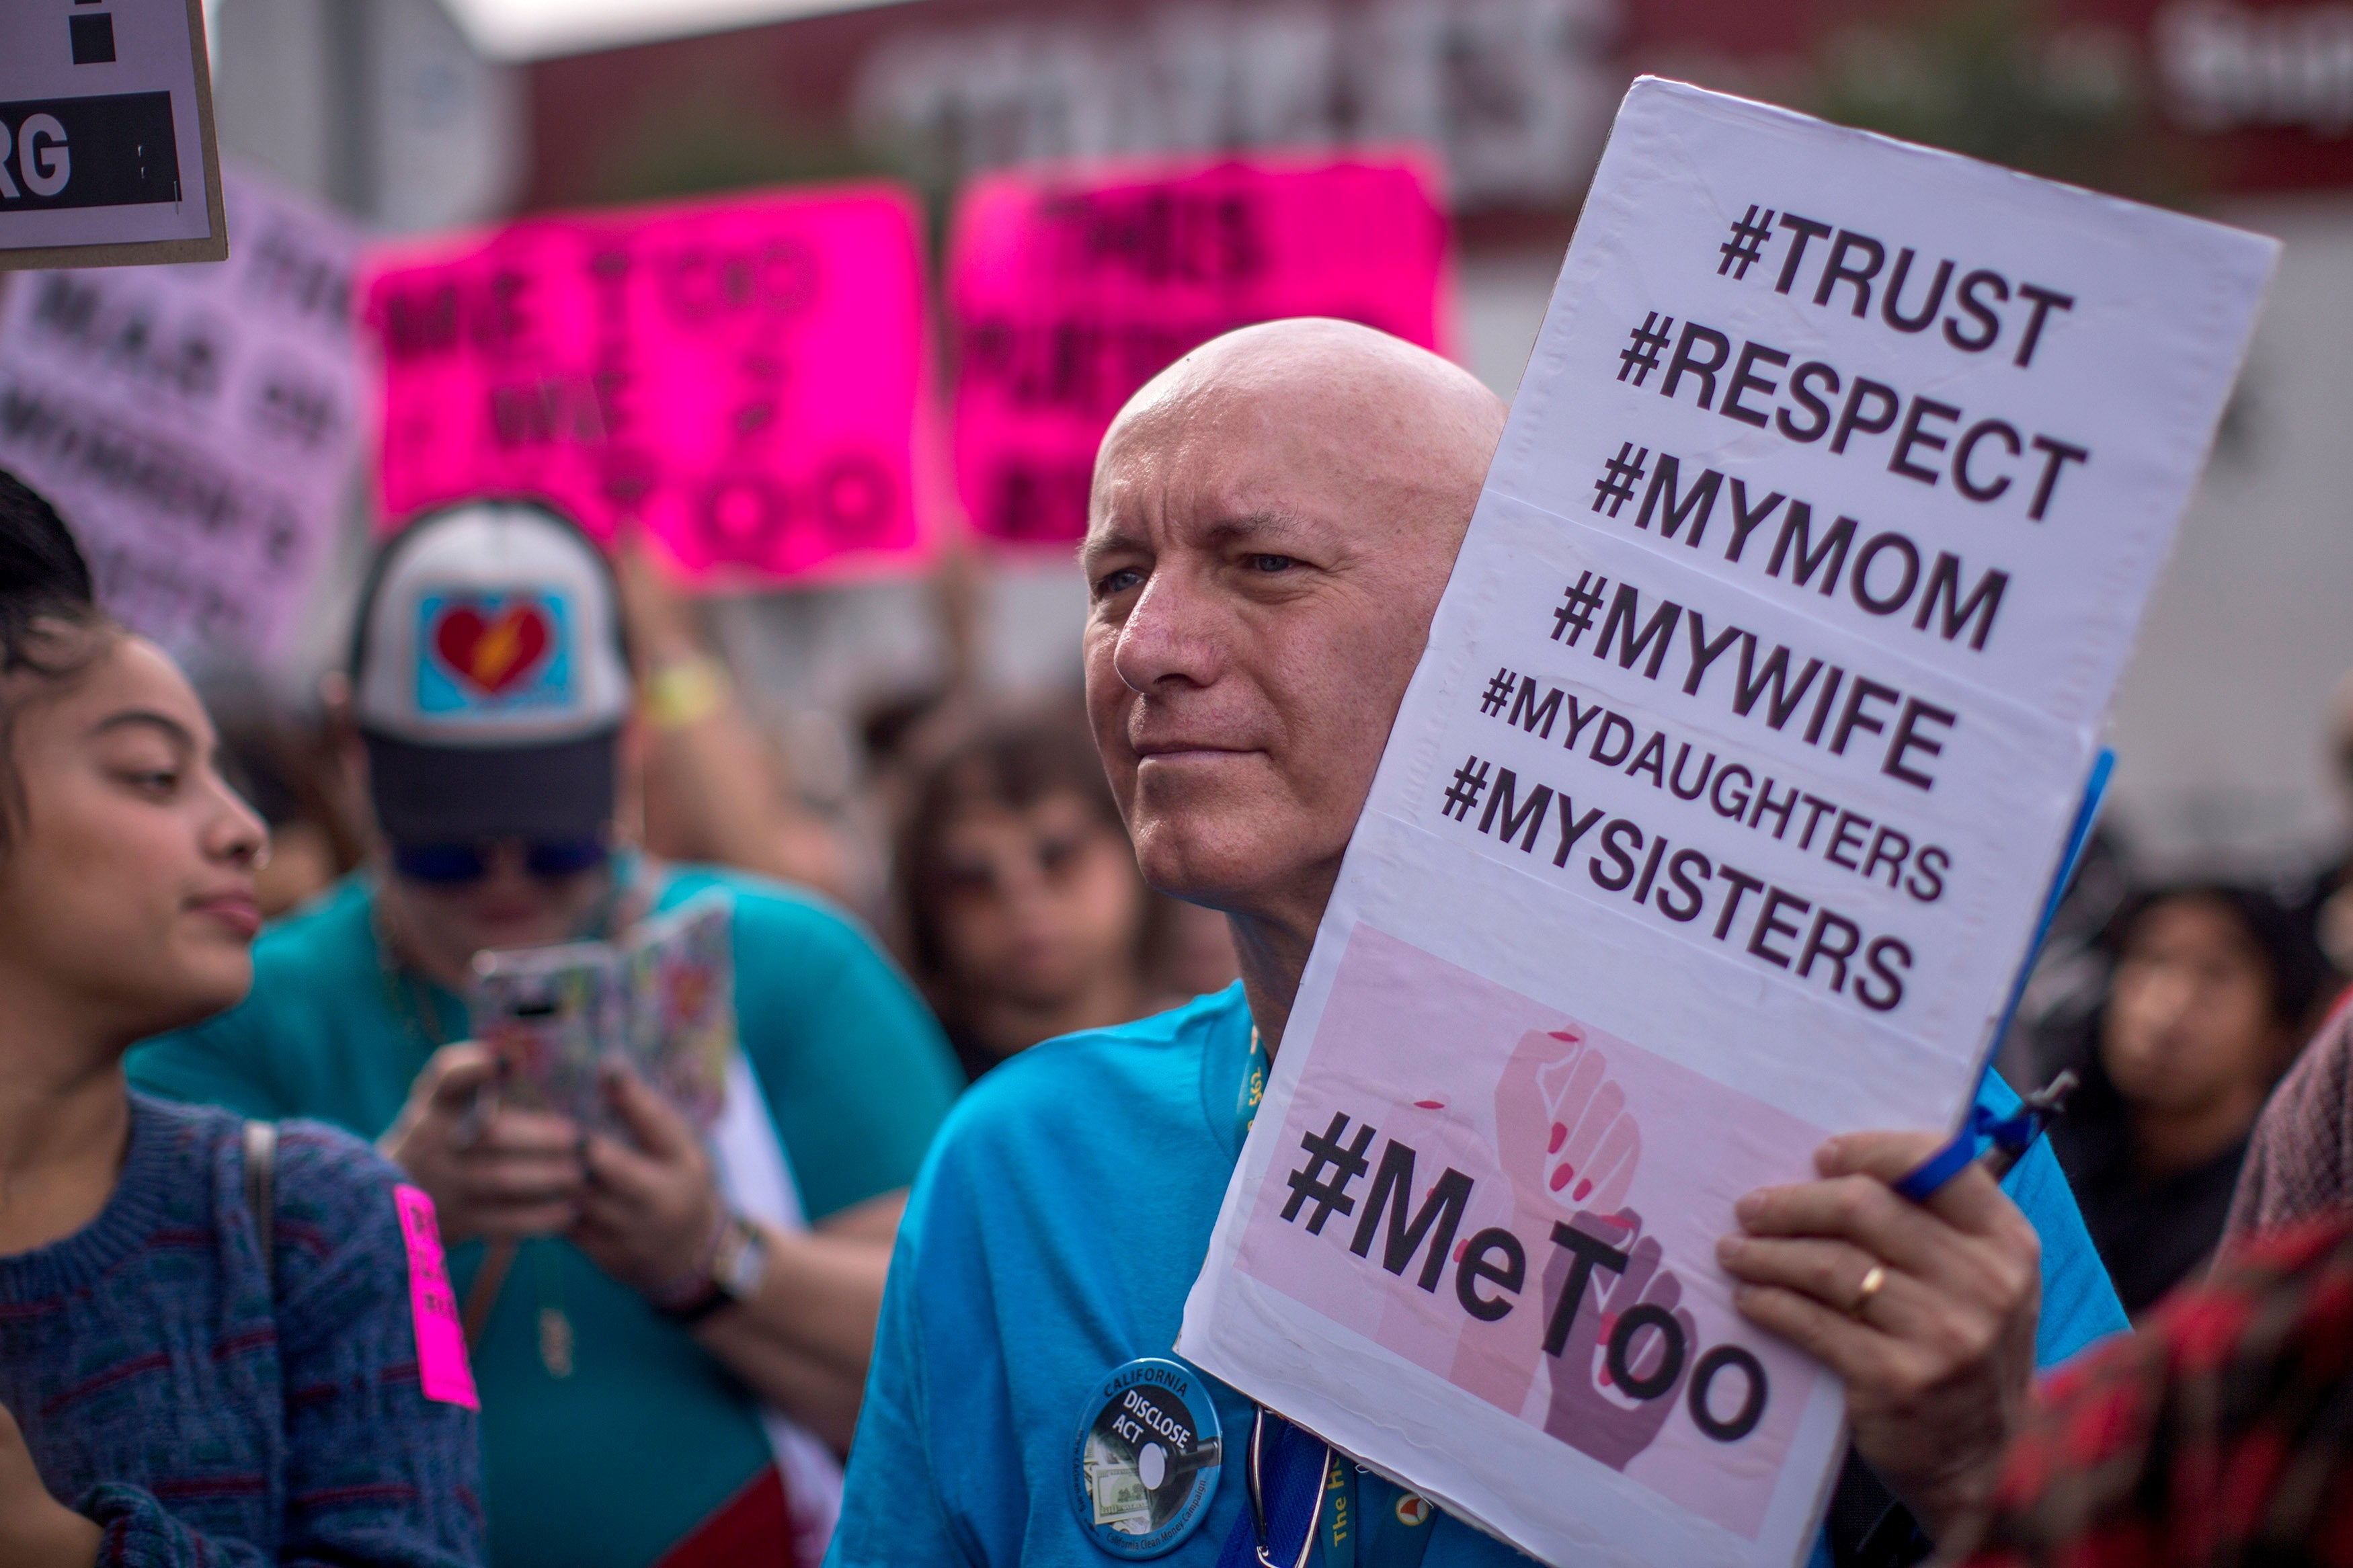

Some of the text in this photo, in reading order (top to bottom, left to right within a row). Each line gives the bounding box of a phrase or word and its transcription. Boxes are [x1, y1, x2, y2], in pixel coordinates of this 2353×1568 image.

[1716, 204, 2075, 369] #TRUST
[1616, 311, 2089, 522] #RESPECT
[1591, 441, 2010, 653] #MYMOM
[1550, 569, 1957, 792] #MYWIFE
[1479, 667, 1951, 903] #MYDAUGHTERS
[1441, 754, 1913, 1013] #MYSISTERS
[1279, 1111, 1769, 1444] #MeToo
[1104, 1368, 1189, 1397] CALIFORNIA
[1113, 1415, 1144, 1444] ACT
[1123, 1389, 1191, 1448] DISCLOSE
[1106, 1479, 1207, 1550] California Clean Money Campaign
[1332, 1495, 1347, 1547] The
